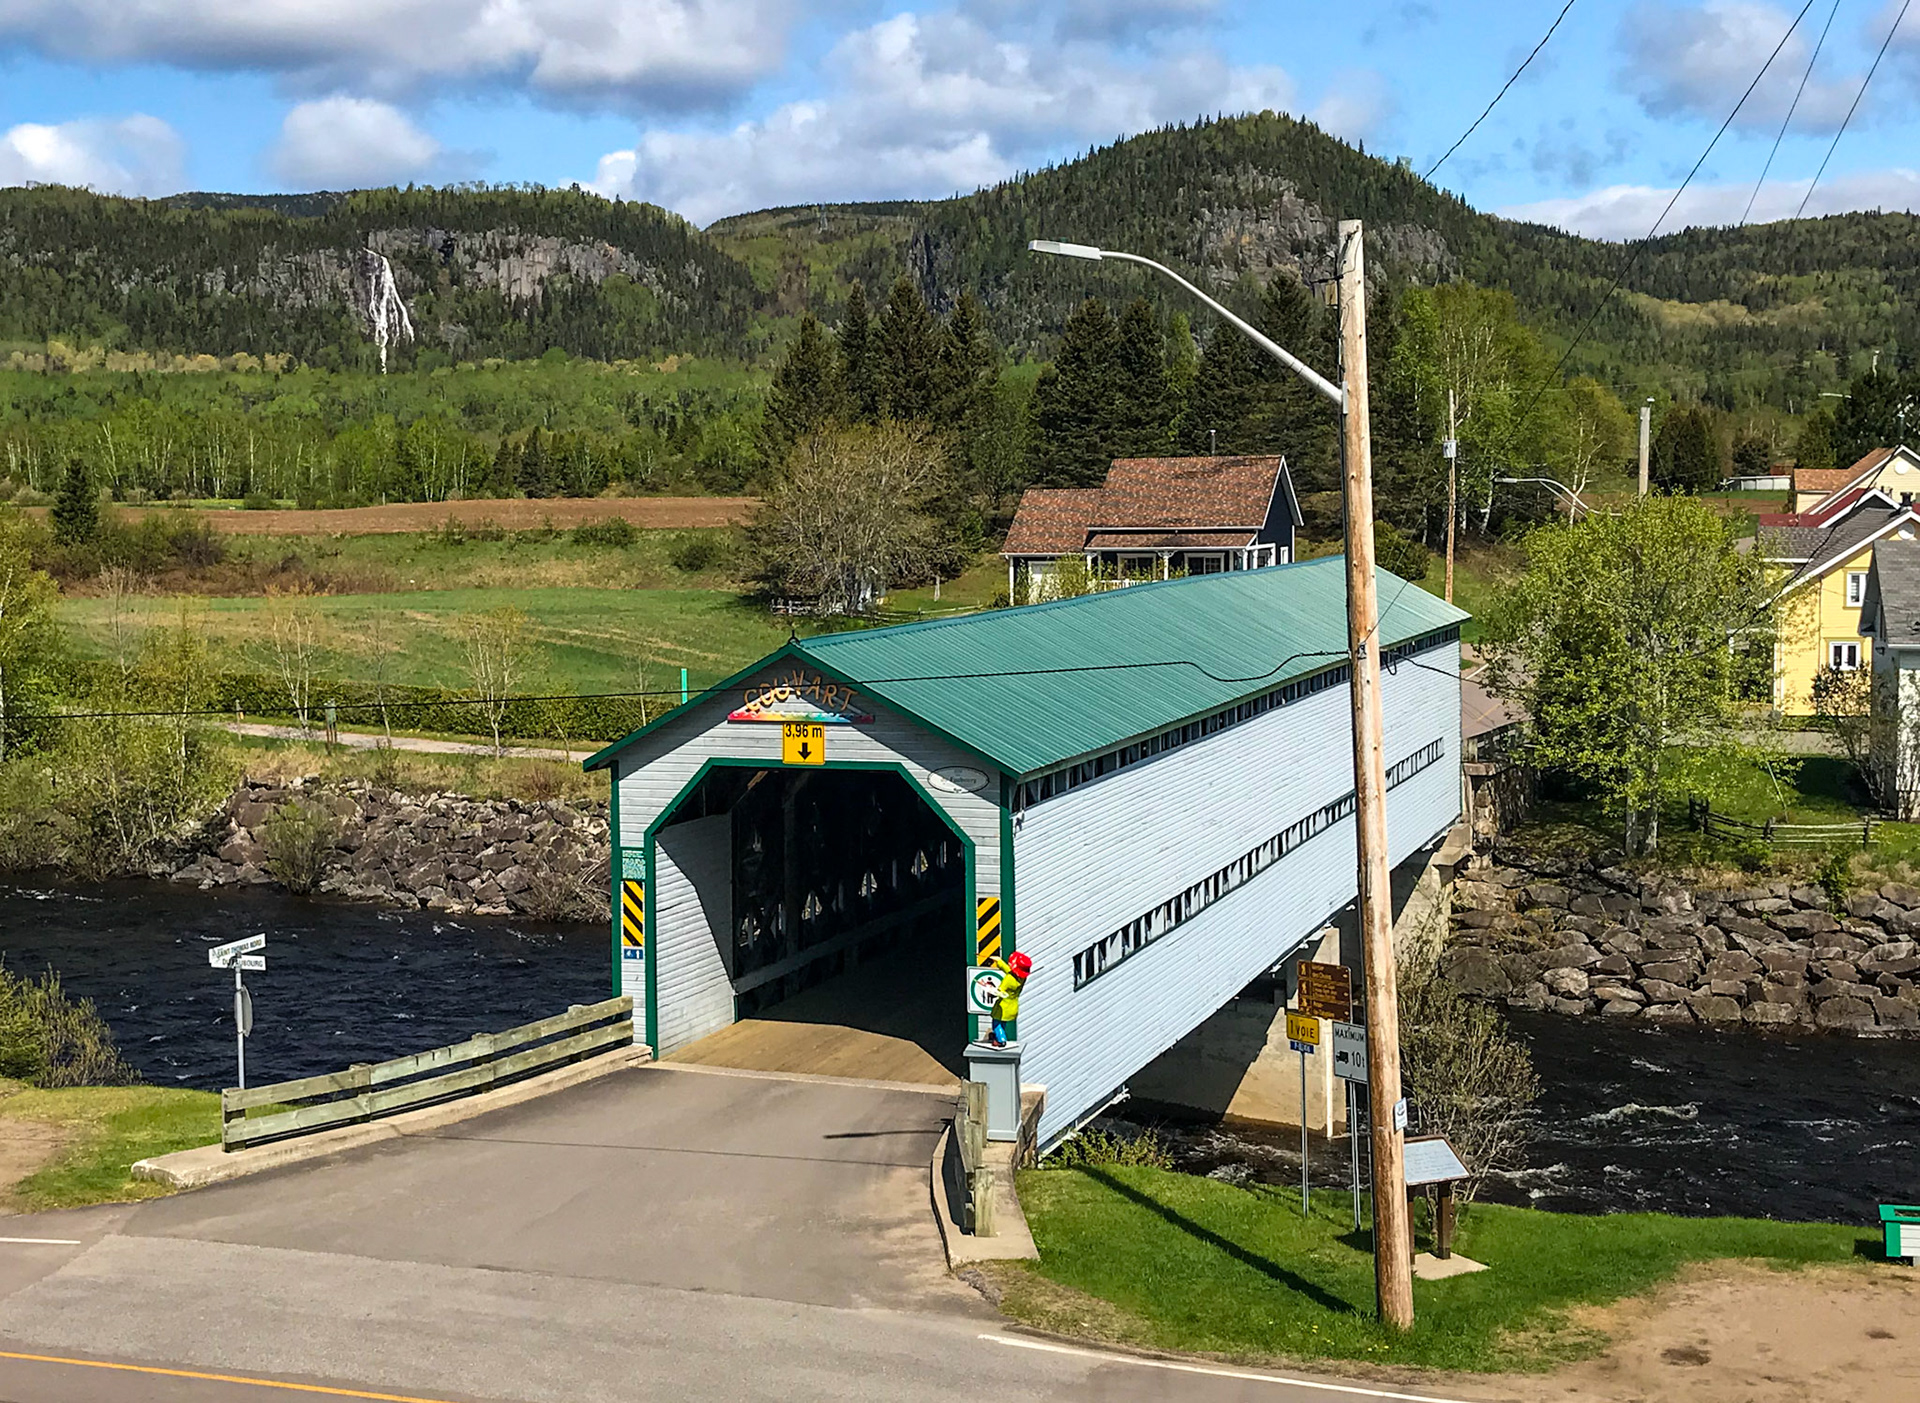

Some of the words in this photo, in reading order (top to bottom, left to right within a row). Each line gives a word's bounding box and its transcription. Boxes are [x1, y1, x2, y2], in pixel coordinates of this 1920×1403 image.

[785, 723, 809, 740] 3,96
[812, 726, 822, 738] m
[1290, 1019, 1294, 1035] 1
[1296, 1026, 1316, 1039] VOIE
[1335, 1028, 1365, 1043] MAXIMUM
